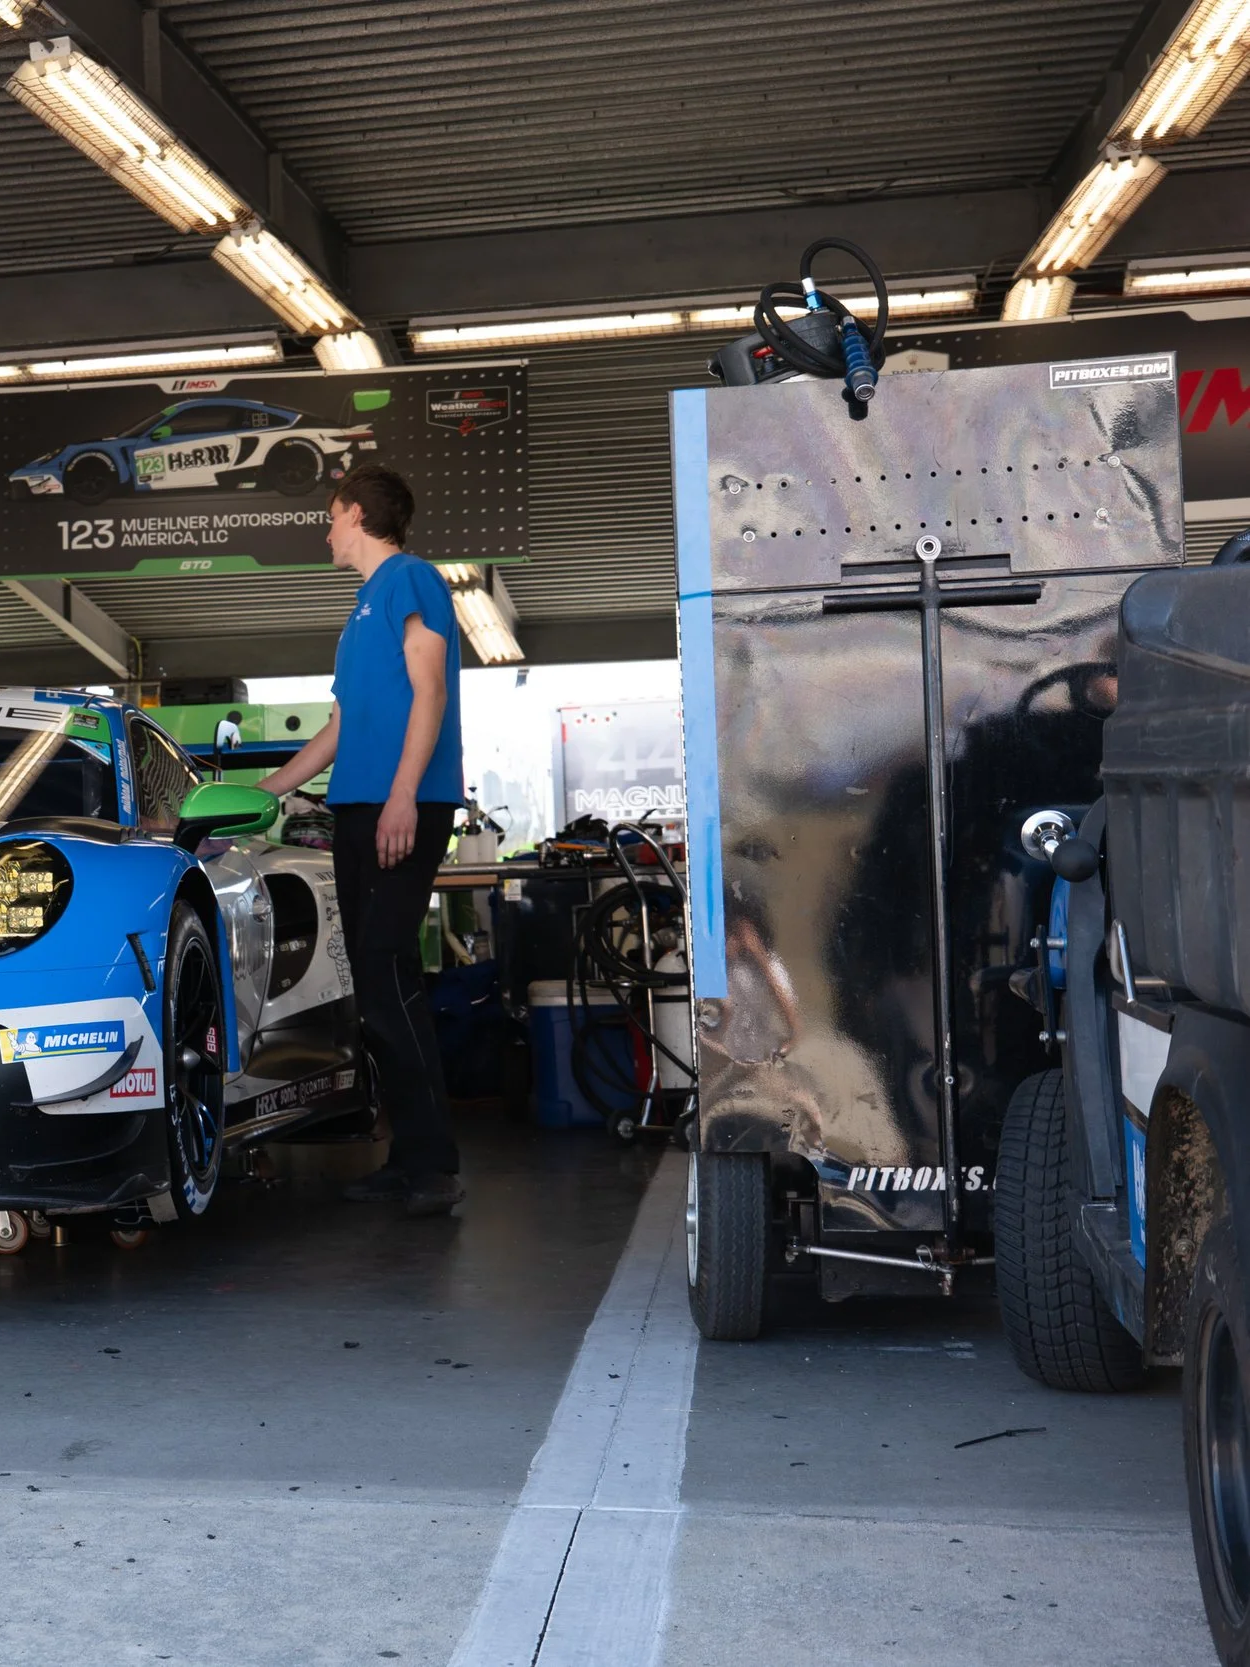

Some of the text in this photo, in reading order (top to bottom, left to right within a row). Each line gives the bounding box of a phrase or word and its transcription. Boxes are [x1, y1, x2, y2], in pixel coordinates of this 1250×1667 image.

[1054, 363, 1167, 381] PITBOXES.COM
[186, 380, 217, 389] IMSA
[137, 456, 164, 474] 123
[168, 448, 208, 471] H&R
[121, 516, 208, 532] MUEHLNER
[58, 519, 114, 550] 123
[121, 530, 228, 547] AMERICA, LLC
[180, 560, 212, 571] GTD
[44, 1031, 118, 1048] MICHELIN
[206, 1027, 217, 1053] BBS
[113, 1073, 154, 1093] MOTUL
[256, 1091, 277, 1117] HRX
[847, 1166, 997, 1191] PITBOXS.
